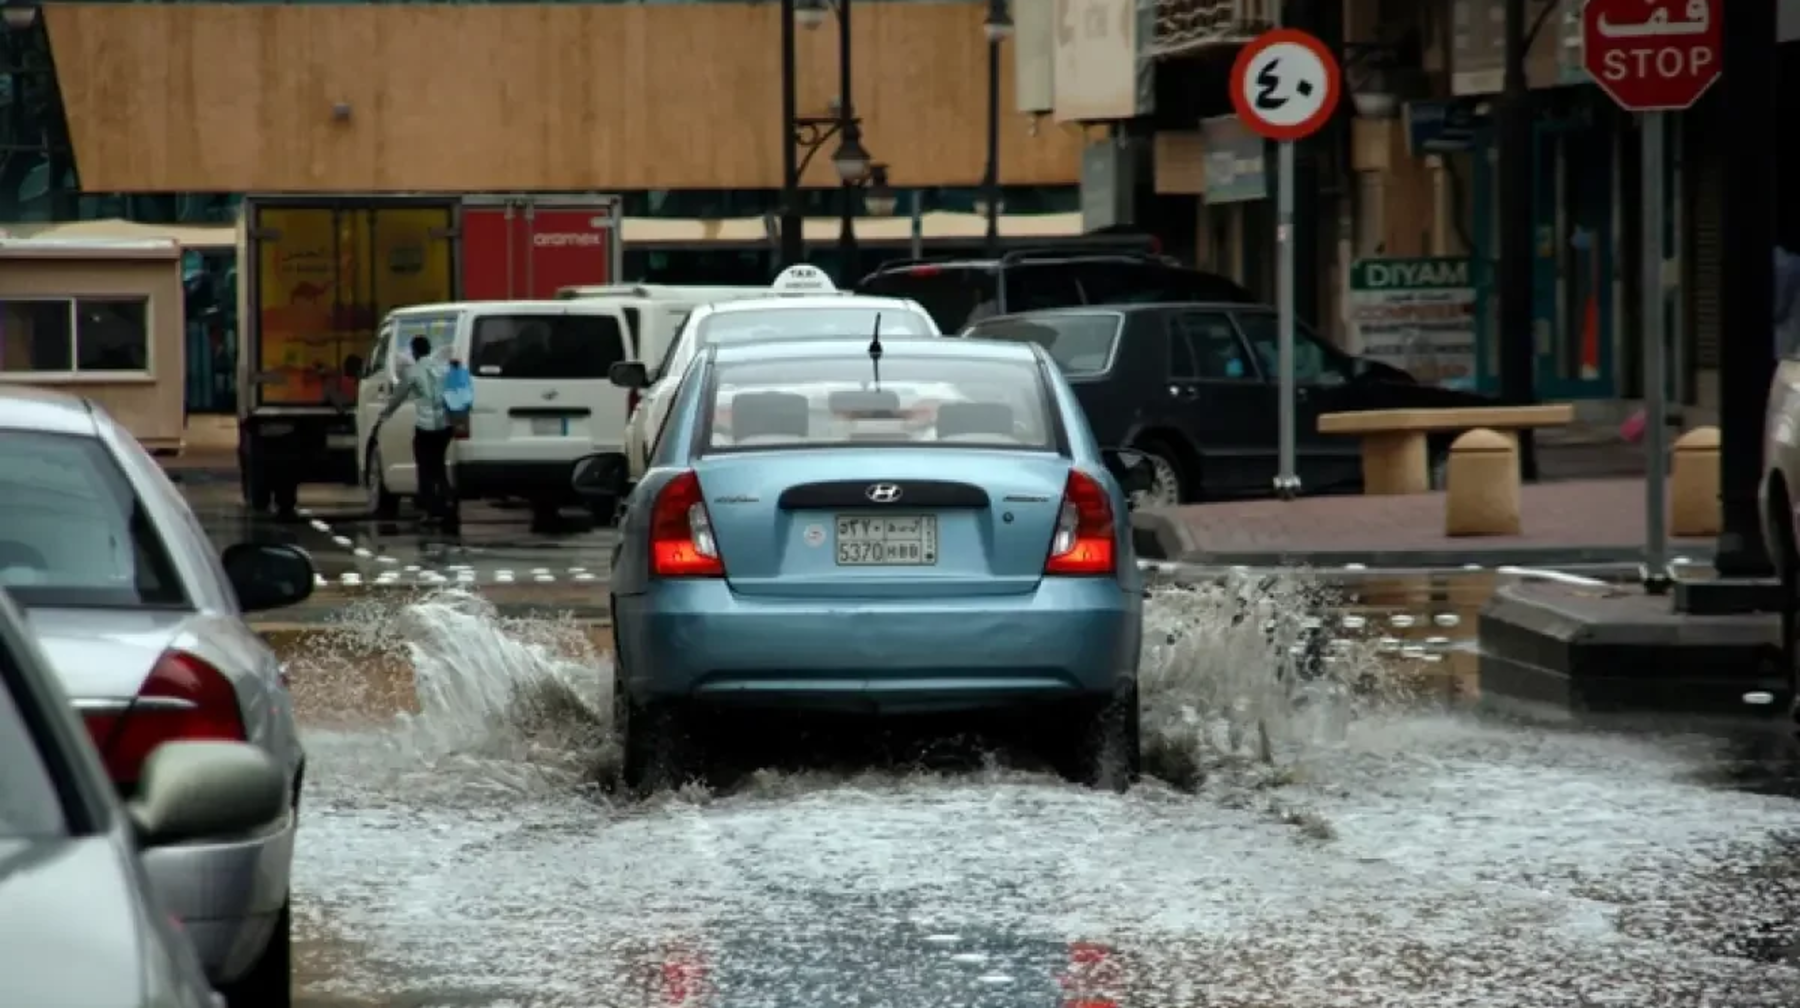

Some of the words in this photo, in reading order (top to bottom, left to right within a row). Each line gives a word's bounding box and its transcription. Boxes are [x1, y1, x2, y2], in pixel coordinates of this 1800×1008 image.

[1597, 0, 1709, 37] قف
[1602, 46, 1713, 80] STOP
[1255, 57, 1313, 110] ٤٠
[533, 232, 601, 246] aramex
[790, 269, 817, 278] TAXI
[1364, 262, 1468, 287] DIYAM
[839, 543, 883, 562] 5370
